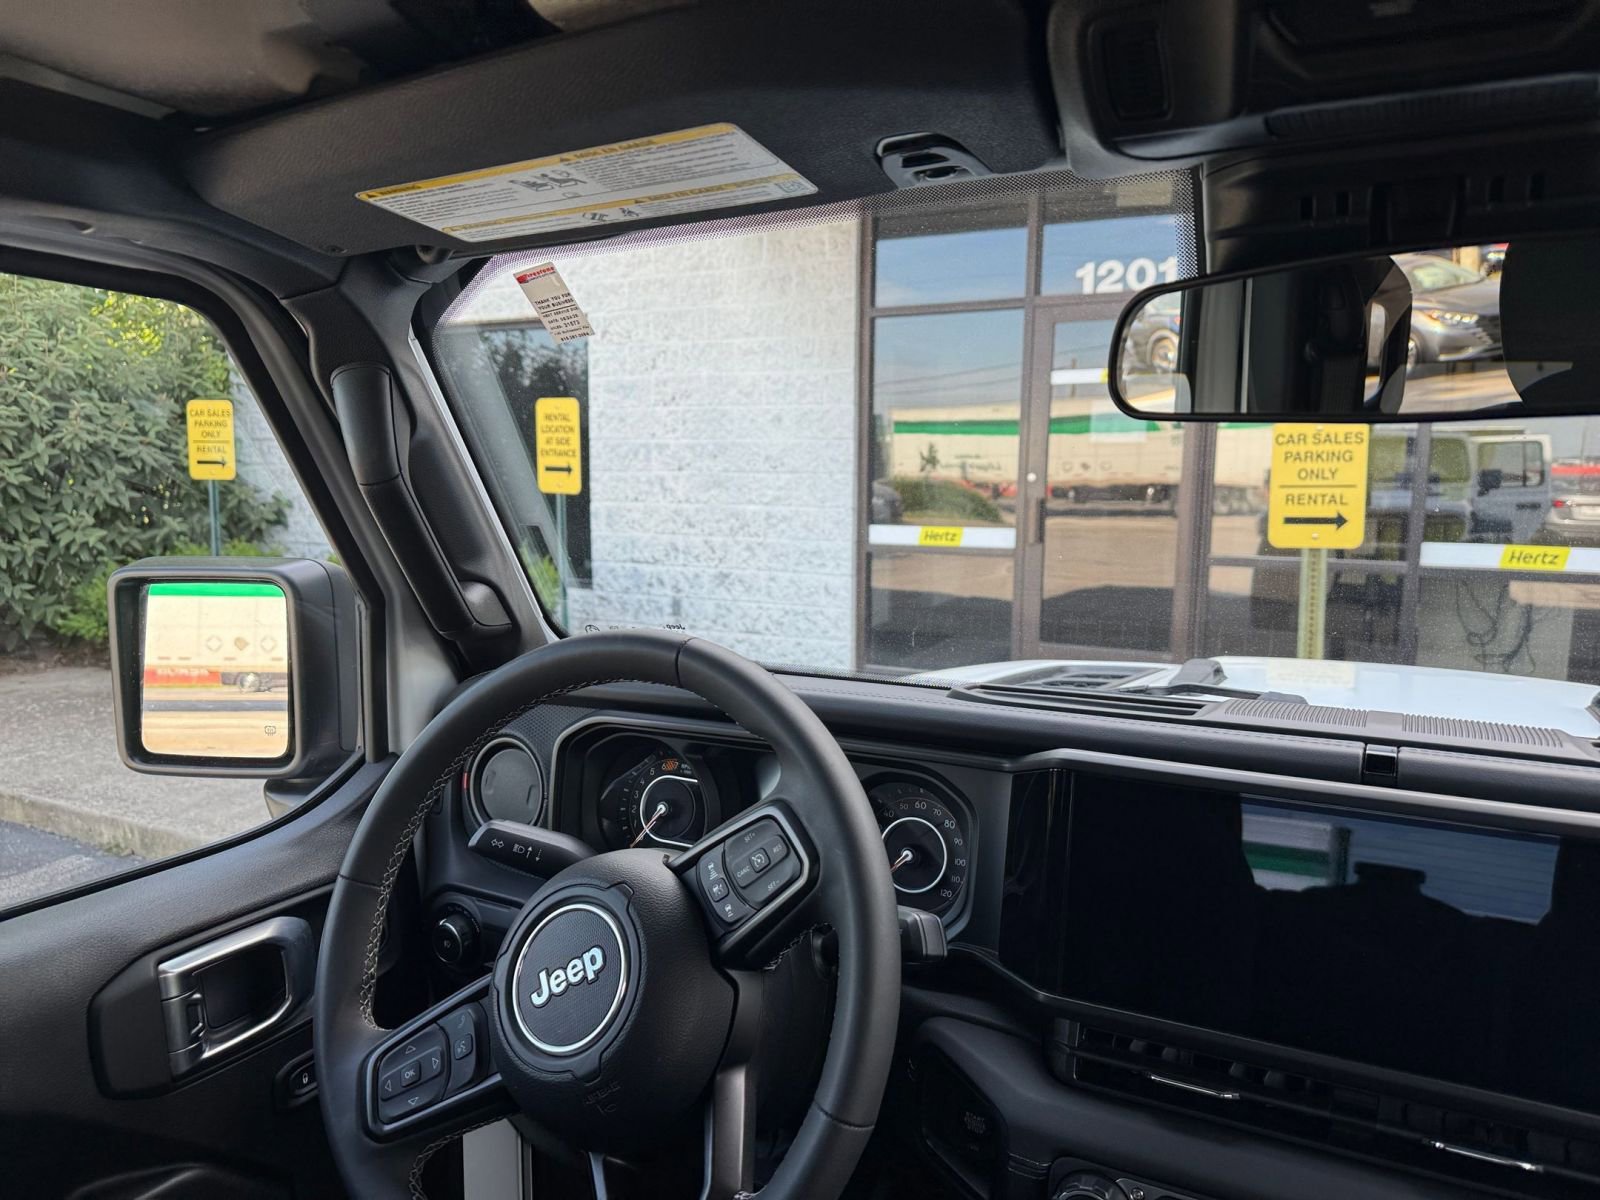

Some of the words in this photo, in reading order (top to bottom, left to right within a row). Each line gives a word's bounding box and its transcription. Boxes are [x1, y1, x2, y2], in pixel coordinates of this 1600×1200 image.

[1076, 256, 1178, 294] 1201
[190, 408, 205, 417] CAR
[207, 408, 231, 417] SALES
[545, 413, 570, 422] RENTAL
[194, 420, 227, 428] PARKING
[541, 424, 575, 433] LOCATION
[1275, 433, 1307, 446] CAR
[1312, 432, 1365, 445] SALES
[197, 445, 226, 454] RENTAL
[1284, 450, 1353, 463] PARKING
[1297, 467, 1339, 481] ONLY
[1285, 493, 1349, 506] RENTAL
[924, 529, 958, 542] Hertz
[1509, 549, 1560, 565] Hertz
[650, 767, 655, 776] 5
[915, 801, 927, 810] 60
[933, 808, 942, 816] 70
[944, 820, 956, 829] 80
[954, 838, 963, 846] 90
[954, 859, 966, 867] 100
[951, 875, 960, 883] 110
[940, 889, 952, 898] 120
[530, 947, 604, 1006] Jeep
[404, 1068, 416, 1079] OK
